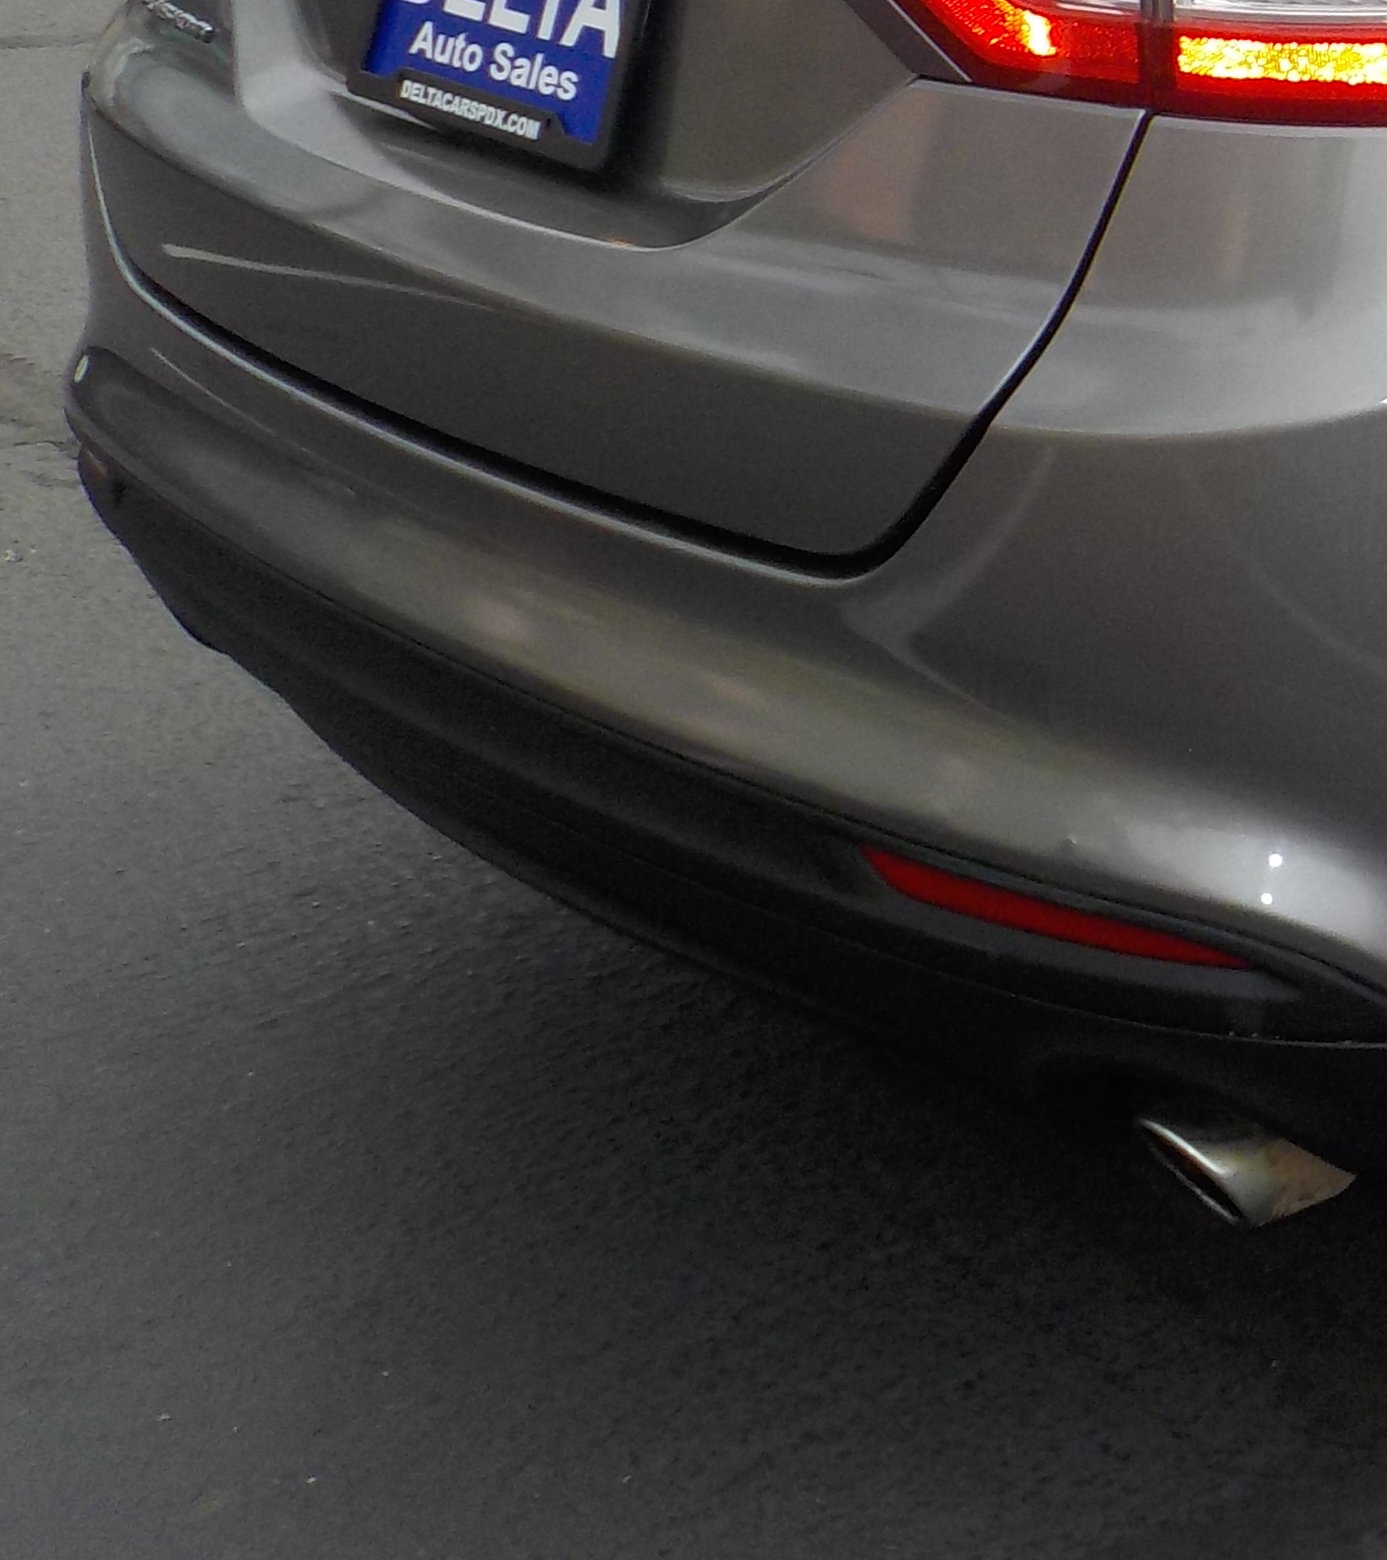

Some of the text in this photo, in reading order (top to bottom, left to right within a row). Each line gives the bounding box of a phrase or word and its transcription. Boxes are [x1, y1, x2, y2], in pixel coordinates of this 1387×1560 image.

[408, 21, 579, 101] Auto Sales
[400, 79, 541, 140] DELTACARSPDX.COM
